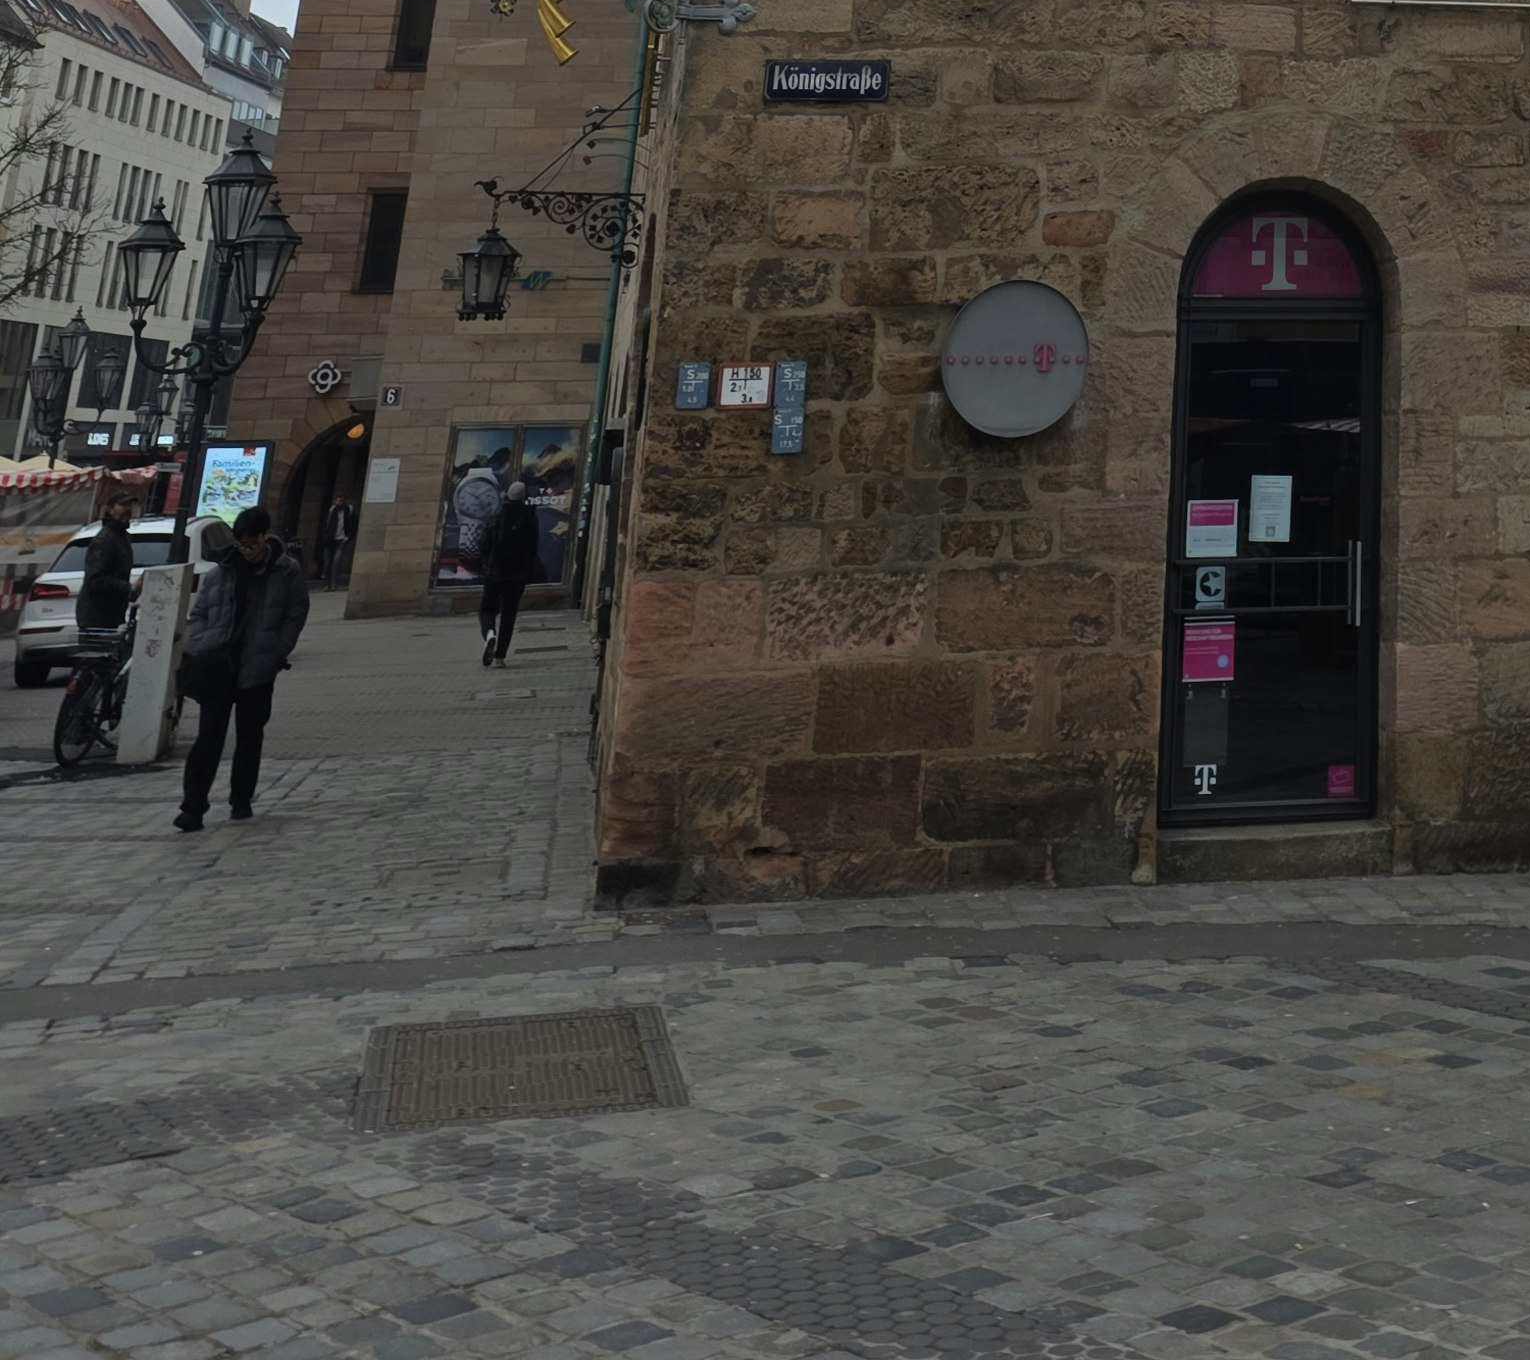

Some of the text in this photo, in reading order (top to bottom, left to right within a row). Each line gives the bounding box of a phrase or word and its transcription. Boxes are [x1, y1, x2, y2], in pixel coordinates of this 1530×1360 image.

[772, 65, 882, 95] Königstraße
[1251, 217, 1308, 291] T
[731, 368, 739, 378] H
[387, 389, 396, 404] 6
[1193, 764, 1217, 795] T
